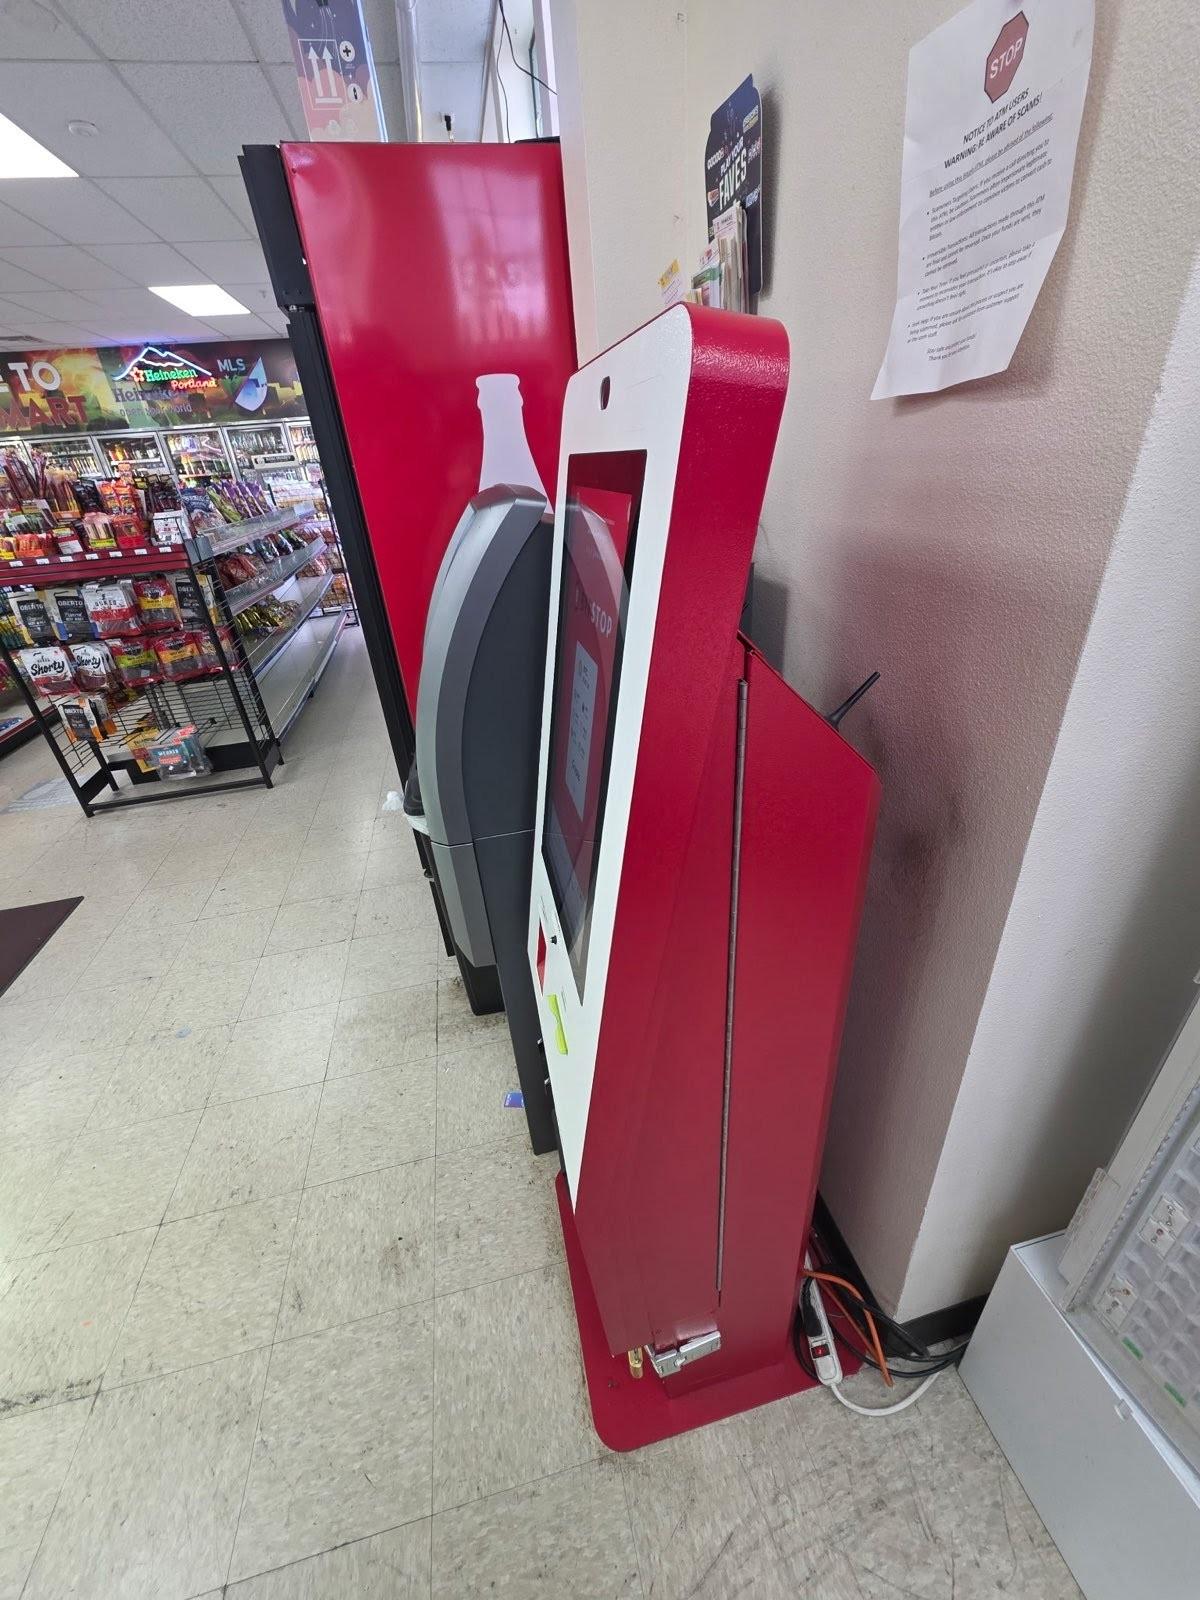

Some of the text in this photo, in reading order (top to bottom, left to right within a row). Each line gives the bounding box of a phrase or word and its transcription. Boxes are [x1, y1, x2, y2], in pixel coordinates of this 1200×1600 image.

[990, 37, 1023, 79] STOP
[963, 121, 986, 144] NOTICE
[994, 104, 1008, 121] ATM
[1008, 88, 1029, 111] USERS
[986, 119, 1007, 142] AWARE
[1007, 113, 1017, 127] OF
[1017, 92, 1042, 120] SCAMS!
[719, 147, 747, 211] FAVES
[7, 361, 61, 392] TO
[144, 367, 198, 382] Heineken
[216, 358, 246, 372] MLS
[170, 377, 217, 390] Portland
[30, 659, 65, 676] Shorty
[77, 655, 101, 669] Shorty
